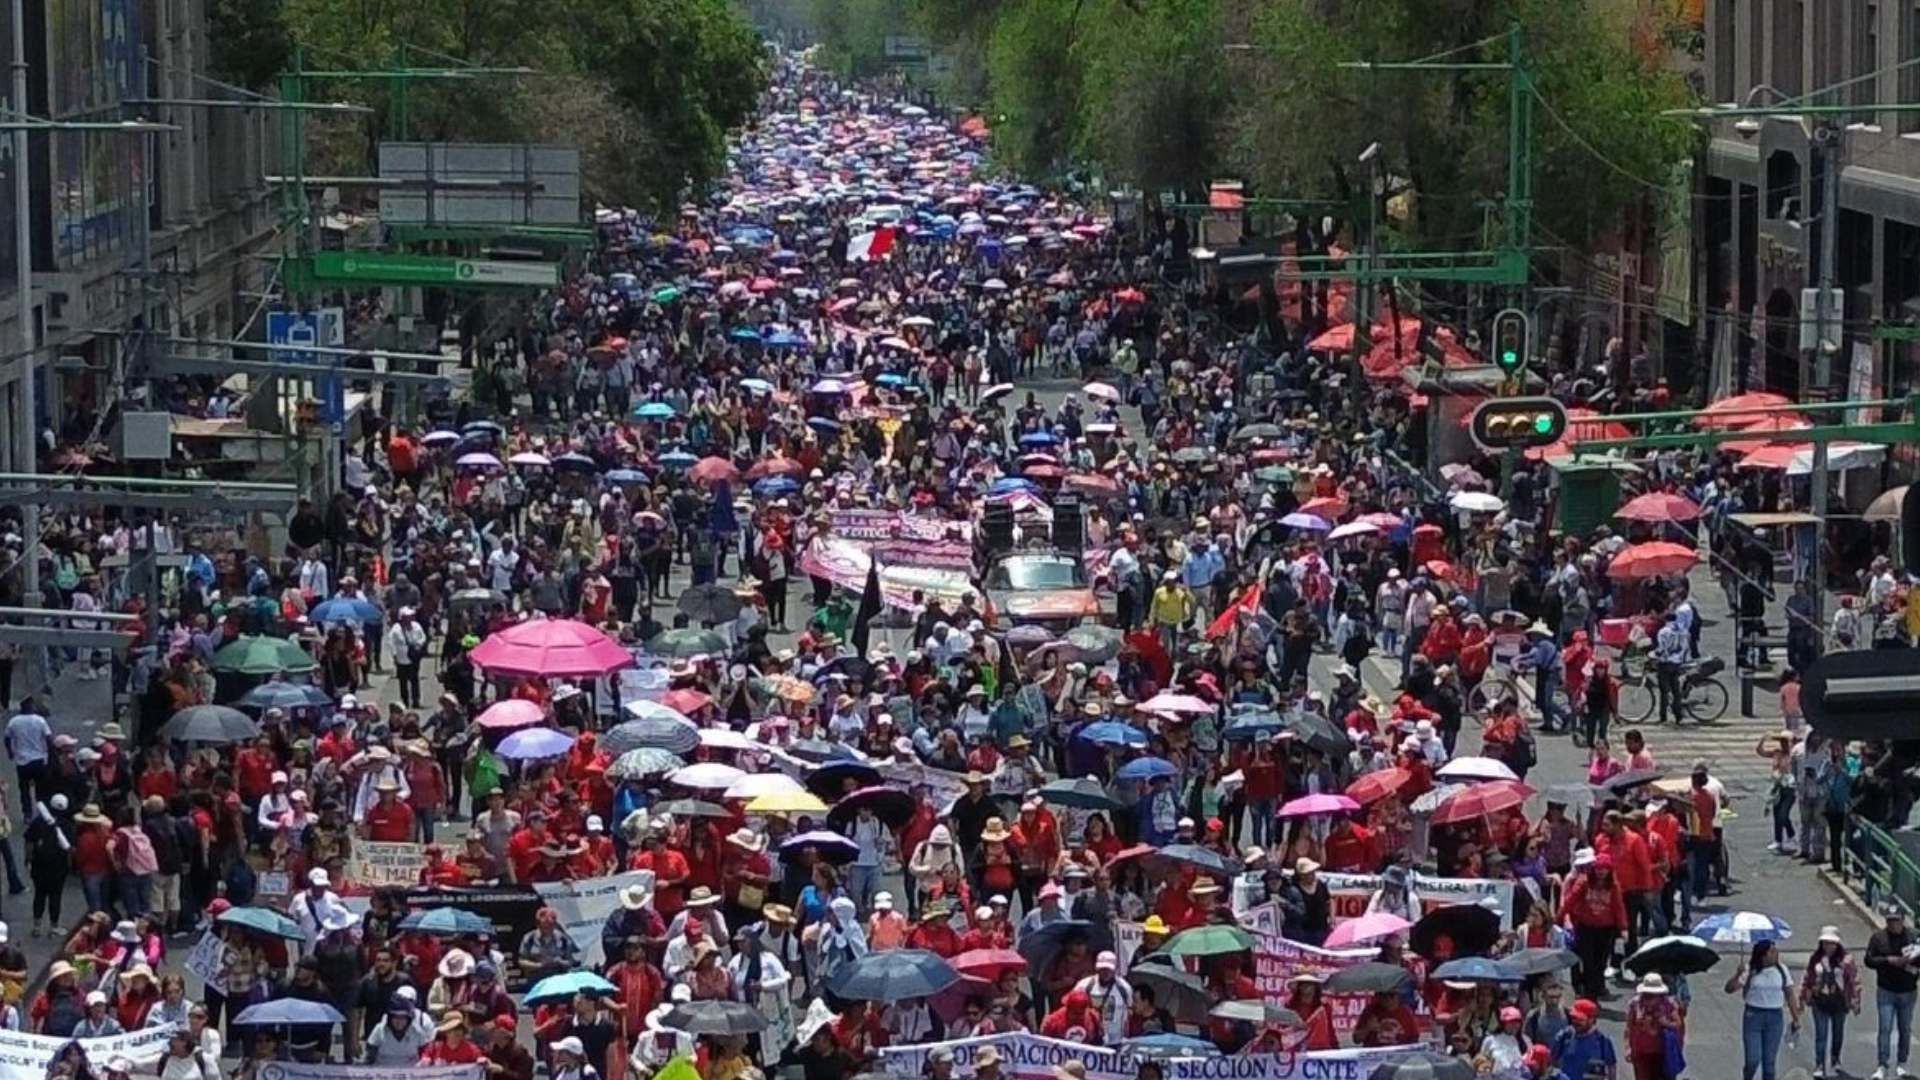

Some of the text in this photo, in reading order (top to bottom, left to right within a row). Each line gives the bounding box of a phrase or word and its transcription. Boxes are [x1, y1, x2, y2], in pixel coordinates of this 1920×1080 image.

[386, 866, 417, 882] MAE
[924, 1042, 1078, 1067] ORNACIÓN
[1177, 1052, 1268, 1079] SECCIÓN
[1273, 1051, 1296, 1080] 9
[1302, 1057, 1359, 1080] CNTE
